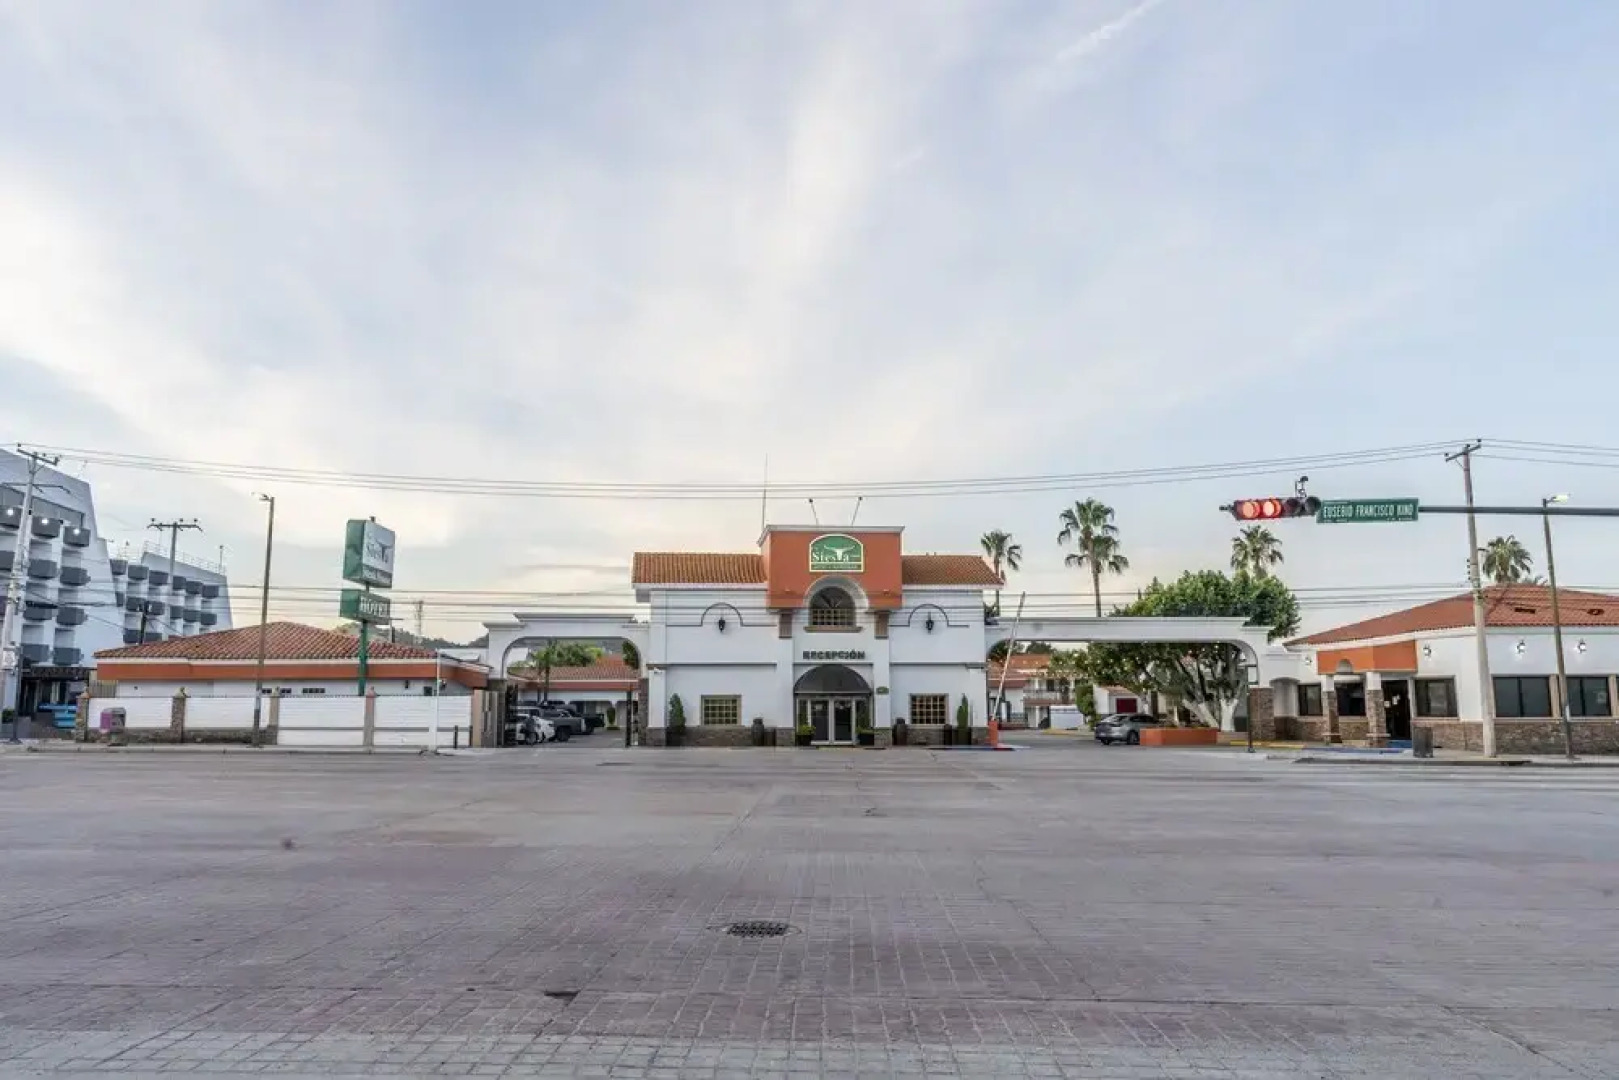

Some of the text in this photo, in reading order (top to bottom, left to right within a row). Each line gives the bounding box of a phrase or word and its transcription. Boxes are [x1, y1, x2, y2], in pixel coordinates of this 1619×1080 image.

[1323, 506, 1353, 518] EUSEBIO
[1356, 504, 1395, 517] FRANCISCO
[803, 649, 866, 660] RECEPCIÓN
